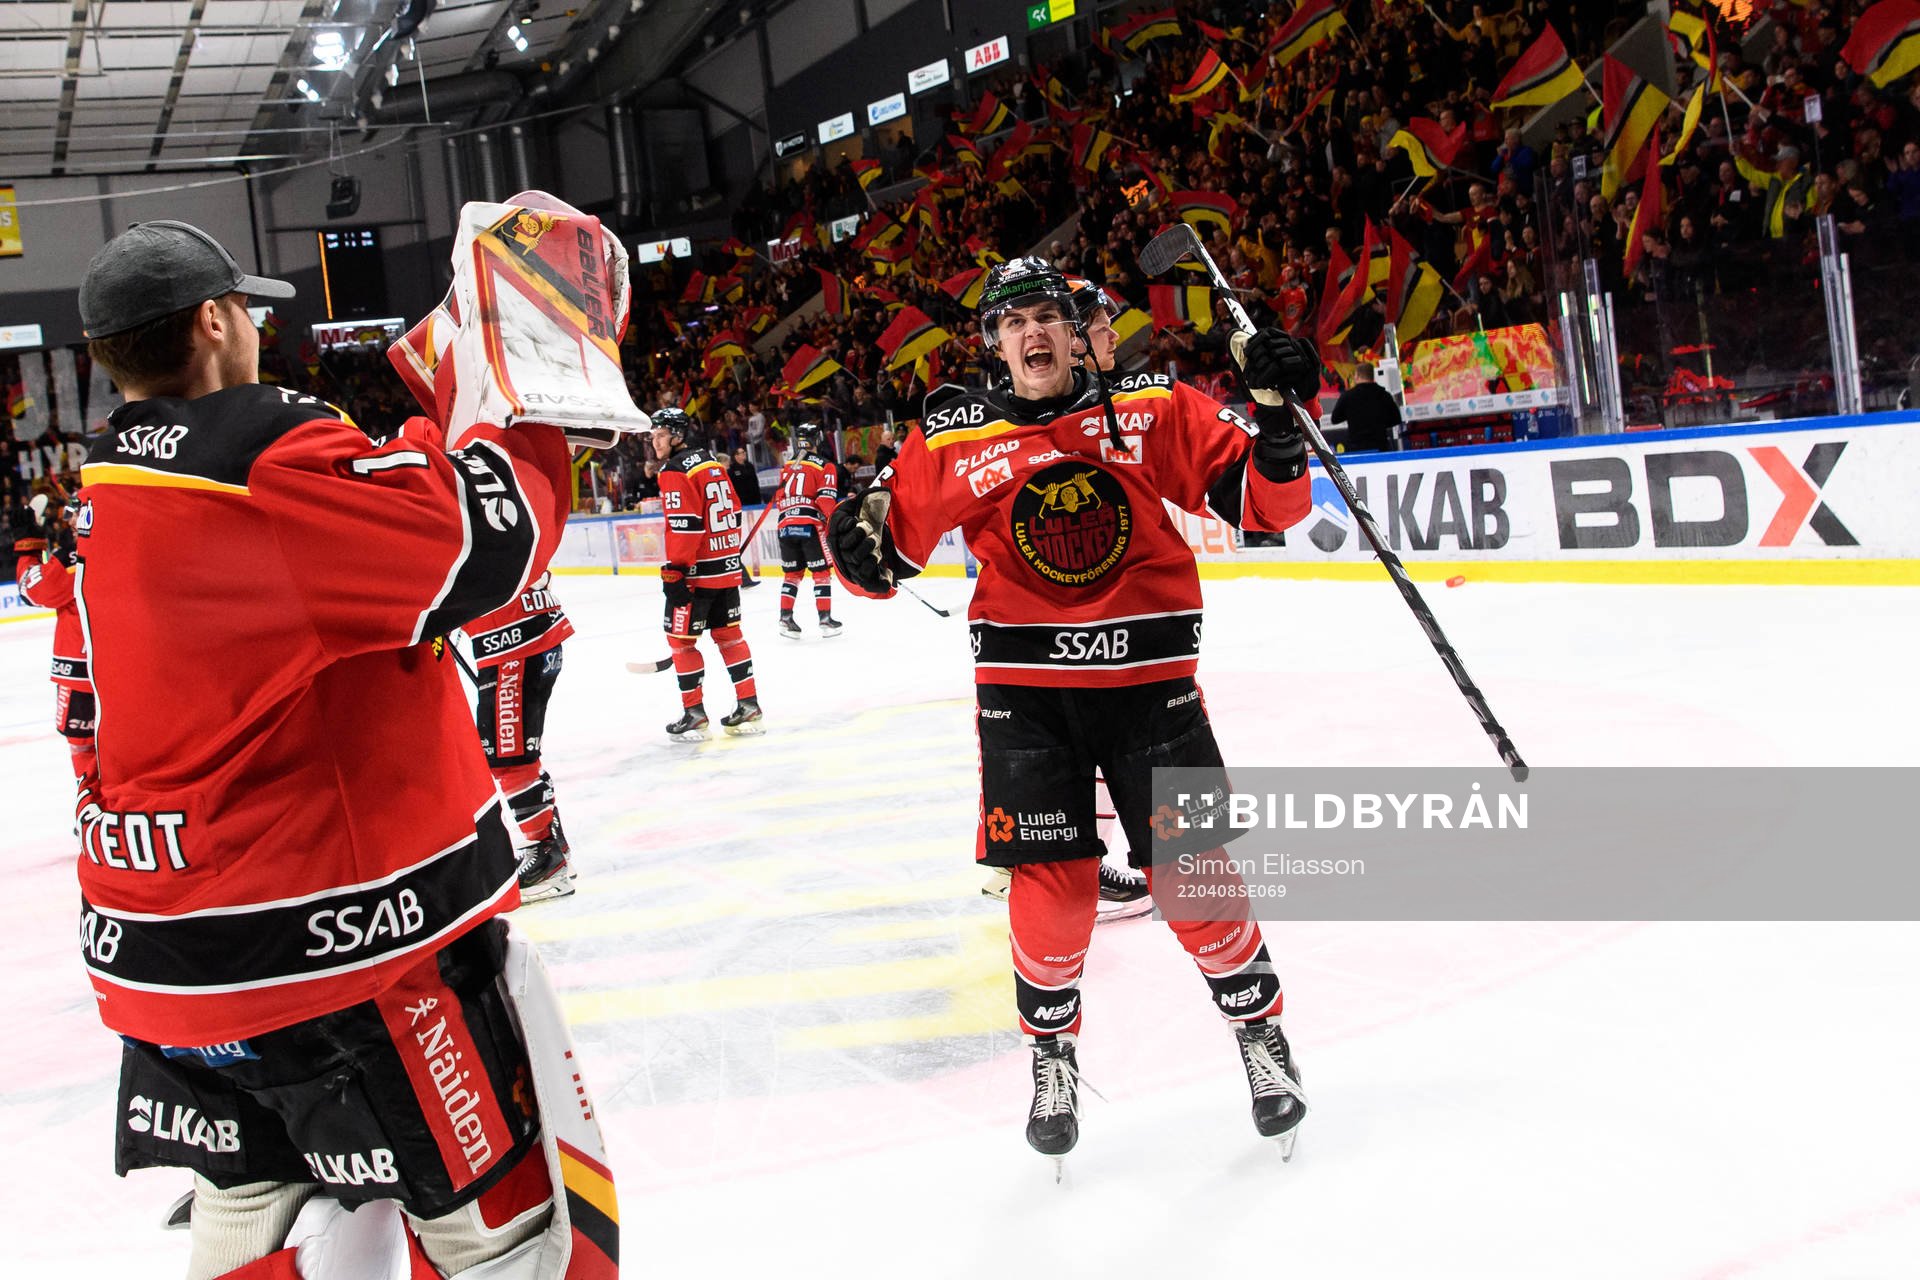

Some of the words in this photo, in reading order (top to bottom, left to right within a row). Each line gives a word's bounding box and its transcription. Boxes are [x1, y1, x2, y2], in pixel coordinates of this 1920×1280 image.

[974, 43, 1000, 67] ABB
[926, 404, 984, 435] SSAB
[116, 425, 189, 460] SSAB
[682, 453, 702, 470] SSAB
[783, 473, 805, 499] 71
[824, 474, 835, 486] 71
[974, 467, 1009, 494] MAX
[665, 491, 681, 509] 25
[706, 480, 737, 533] 25
[1550, 441, 1860, 549] BDX
[1356, 467, 1509, 552] LKAB
[1015, 522, 1036, 561] LULEÅ
[1034, 535, 1128, 584] HOCKEYFÖRENING
[1118, 505, 1129, 532] 1977
[482, 628, 522, 653] SSAB
[1049, 629, 1129, 660] SSAB
[981, 708, 1012, 720] AUER
[1018, 809, 1067, 827] Luleå
[1020, 824, 1078, 842] Energi
[305, 888, 425, 957] SSAB
[1199, 926, 1241, 954] BAUER
[1043, 948, 1088, 963] BAUER
[1220, 978, 1262, 1008] NEX
[1033, 995, 1079, 1021] NEX
[153, 1100, 241, 1153] LKAB
[317, 1148, 400, 1186] LKAB
